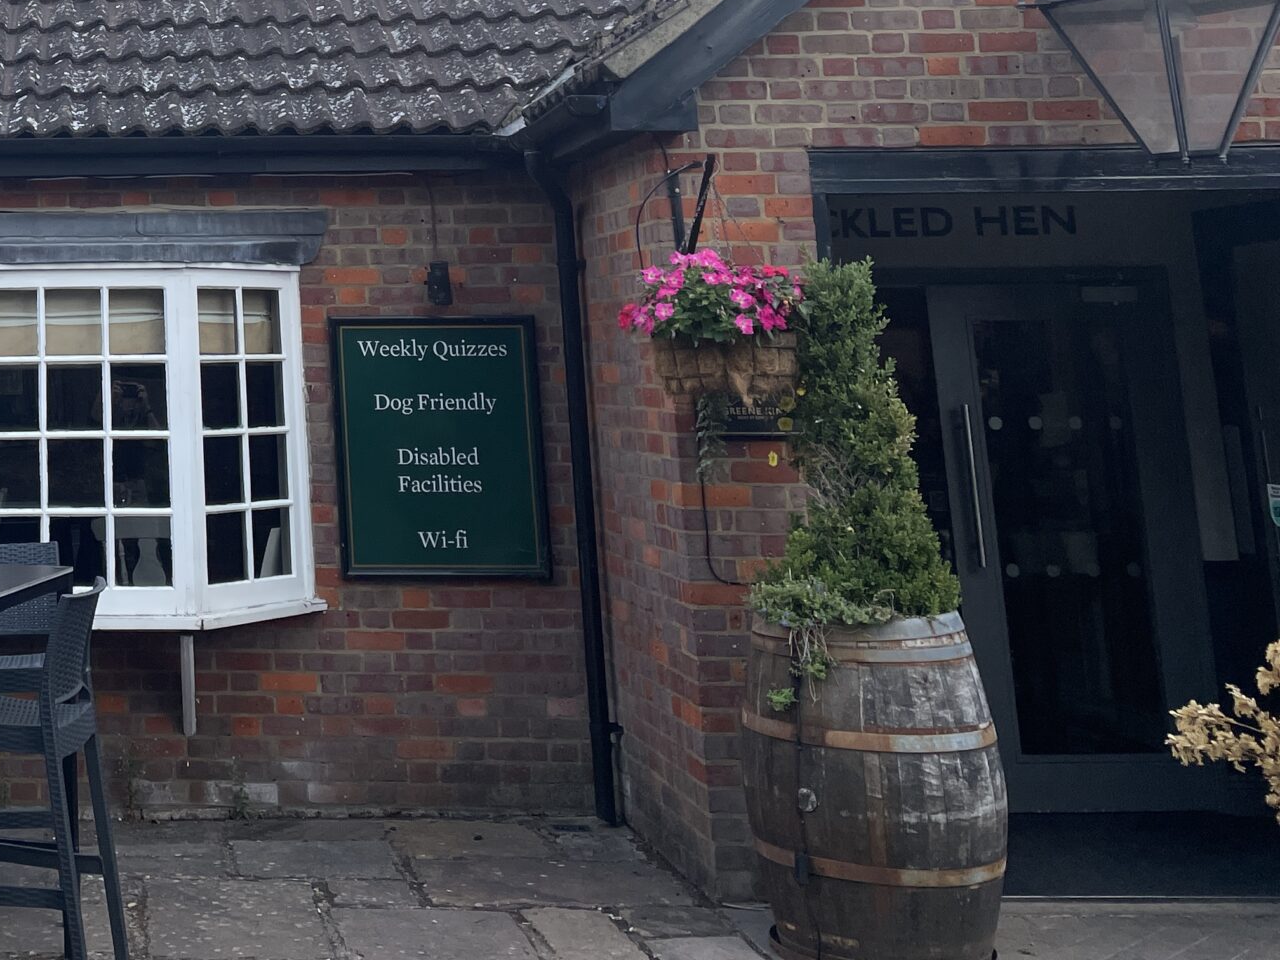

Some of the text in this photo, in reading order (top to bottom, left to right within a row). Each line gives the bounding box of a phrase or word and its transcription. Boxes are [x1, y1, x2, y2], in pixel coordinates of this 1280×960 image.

[974, 204, 1077, 236] HEN
[357, 339, 508, 361] Weekly Quizzes
[374, 392, 497, 415] Dog Friendly
[397, 447, 480, 465] Disabled
[397, 474, 483, 493] Facilities
[417, 529, 469, 549] Wi-fi
